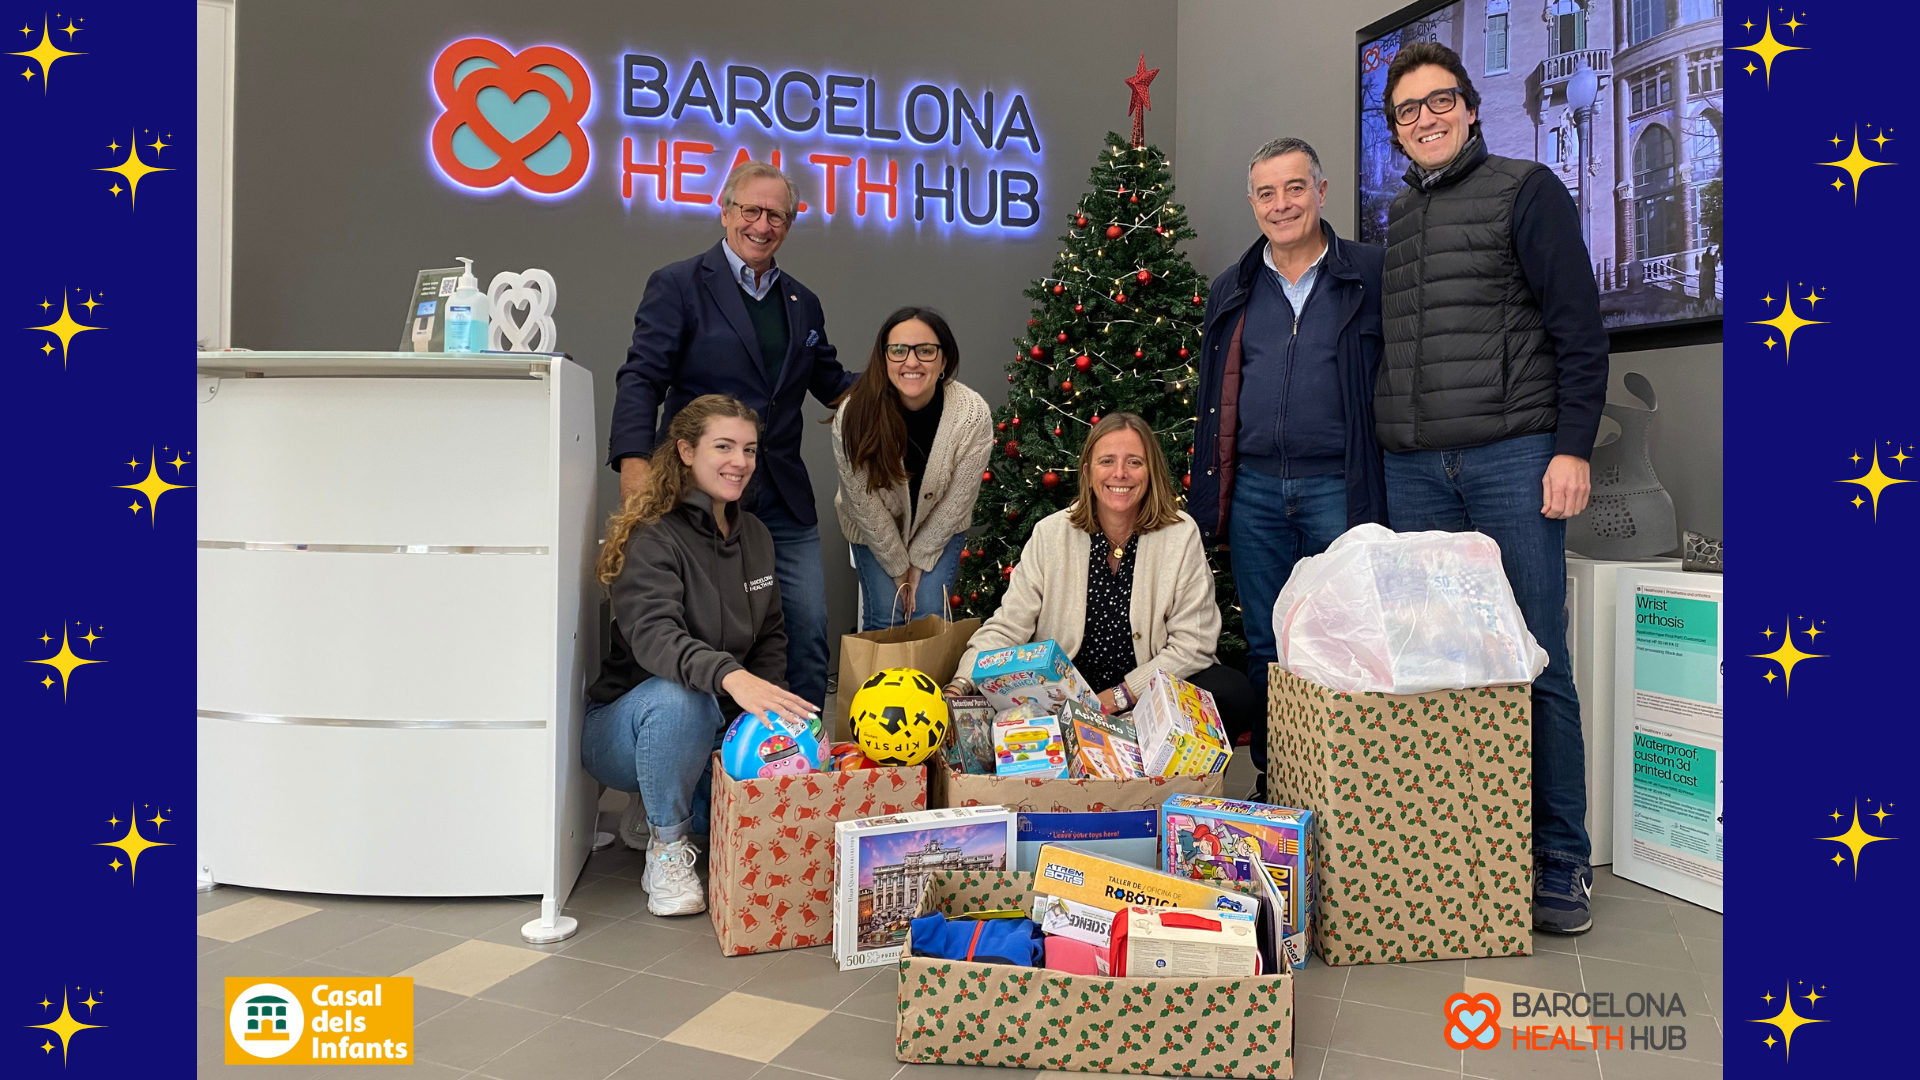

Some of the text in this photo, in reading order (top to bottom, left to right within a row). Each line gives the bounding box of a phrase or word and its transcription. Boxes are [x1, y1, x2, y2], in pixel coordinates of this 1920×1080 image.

[623, 53, 1041, 154] BARCELONA
[914, 163, 1040, 229] HUB
[1636, 596, 1668, 611] Wrist
[1636, 613, 1684, 629] orthosis
[1075, 709, 1124, 734] Aprendo
[1090, 711, 1104, 721] Yo
[865, 739, 920, 752] KIPSTA
[1634, 734, 1699, 761] Waterproof,
[1634, 750, 1691, 772] custom 3d
[1634, 763, 1672, 780] printed
[1673, 773, 1698, 787] cast
[1053, 831, 1072, 839] Leave
[1073, 832, 1087, 840] your
[1089, 832, 1103, 840] toys
[1044, 868, 1084, 886] BOTS
[1046, 862, 1084, 877] XTREM
[1108, 876, 1131, 887] TALLER
[1132, 882, 1142, 890] DE
[1146, 885, 1172, 898] OFICINA
[1069, 913, 1106, 934] SCIENCE
[846, 951, 900, 967] 500 PUZZL
[1283, 939, 1301, 962] Diset
